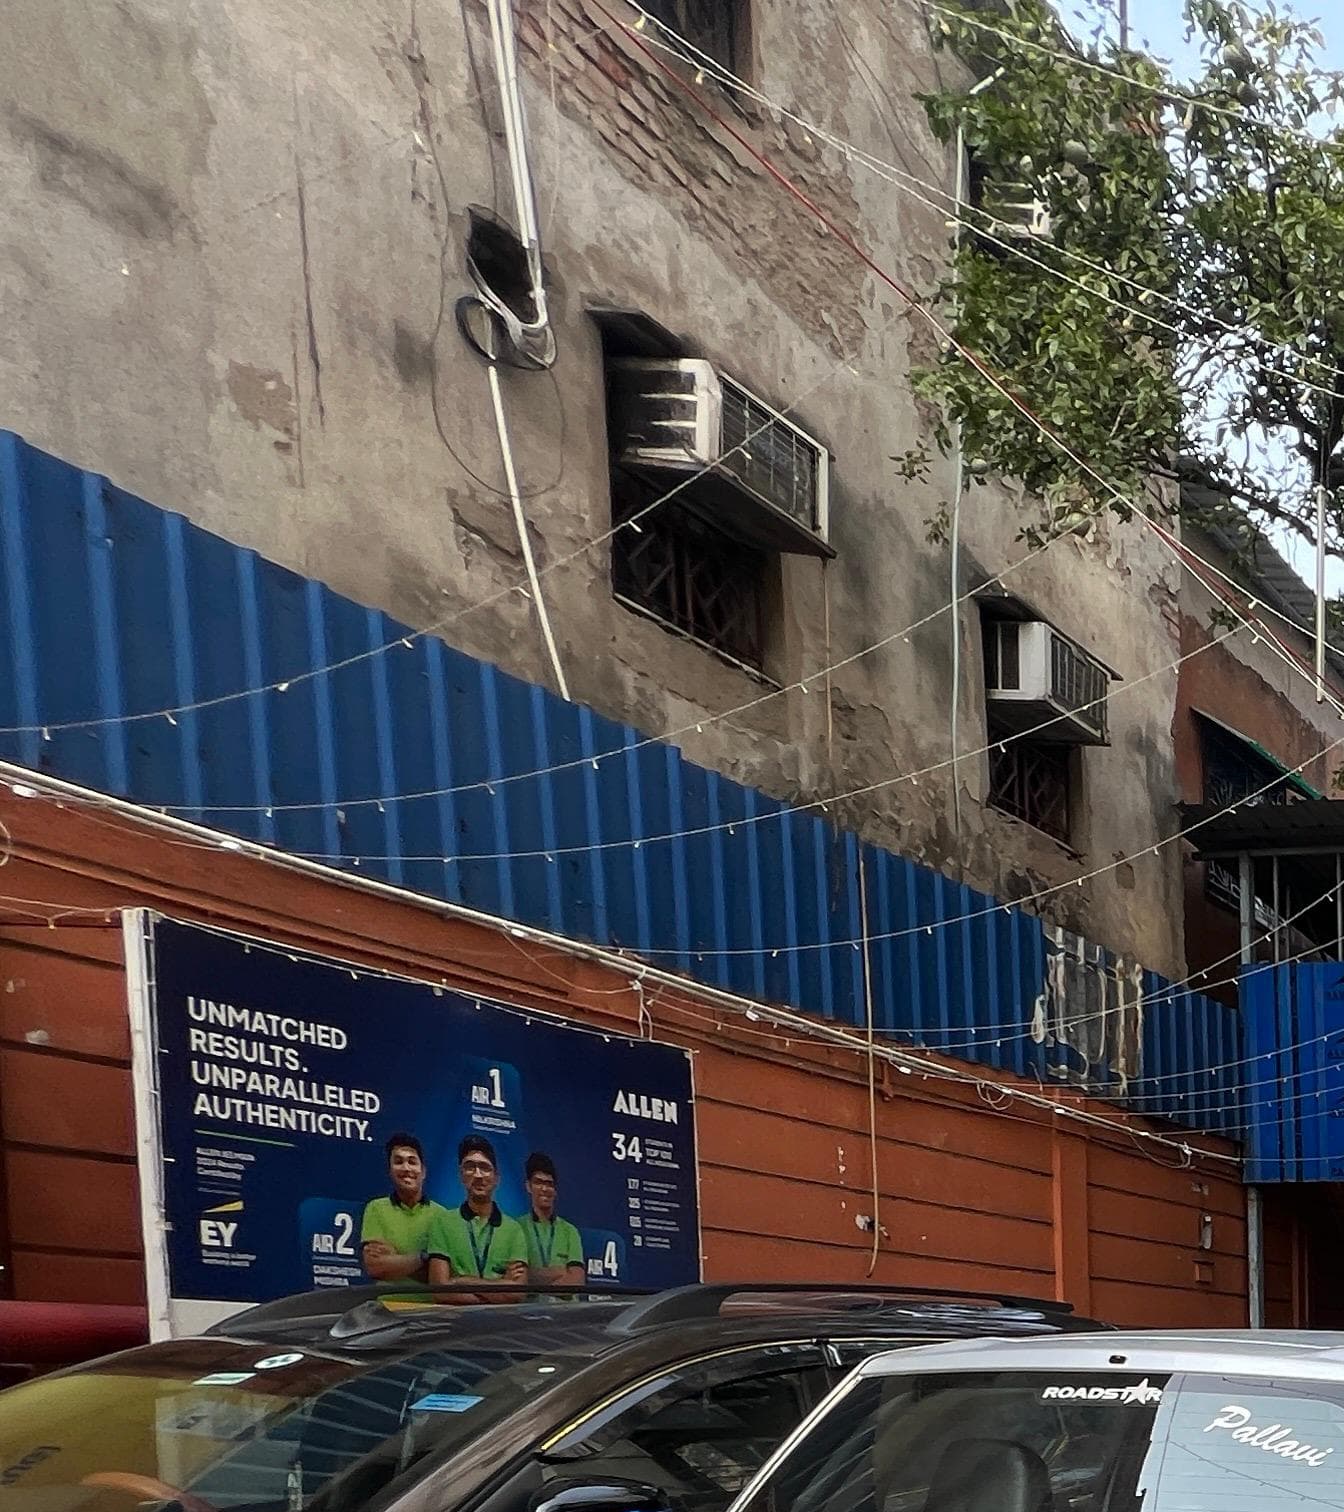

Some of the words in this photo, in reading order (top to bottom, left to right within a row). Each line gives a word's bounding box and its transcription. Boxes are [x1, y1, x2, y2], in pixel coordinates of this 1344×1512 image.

[187, 996, 348, 1050] UNMATCHED
[189, 1028, 309, 1073] RESULTS.
[191, 1060, 381, 1114] UNPARALLELED
[489, 1068, 505, 1108] 1
[613, 1089, 678, 1124] ALLEN
[194, 1093, 373, 1142] AUTHENTICITY.
[612, 1132, 643, 1163] 34
[200, 1219, 237, 1247] EY
[313, 1233, 333, 1254] AIR
[334, 1212, 354, 1255] 2
[604, 1241, 618, 1277] 4
[1042, 1378, 1163, 1405] ROADSTAR
[1203, 1405, 1334, 1467] Pallavi
